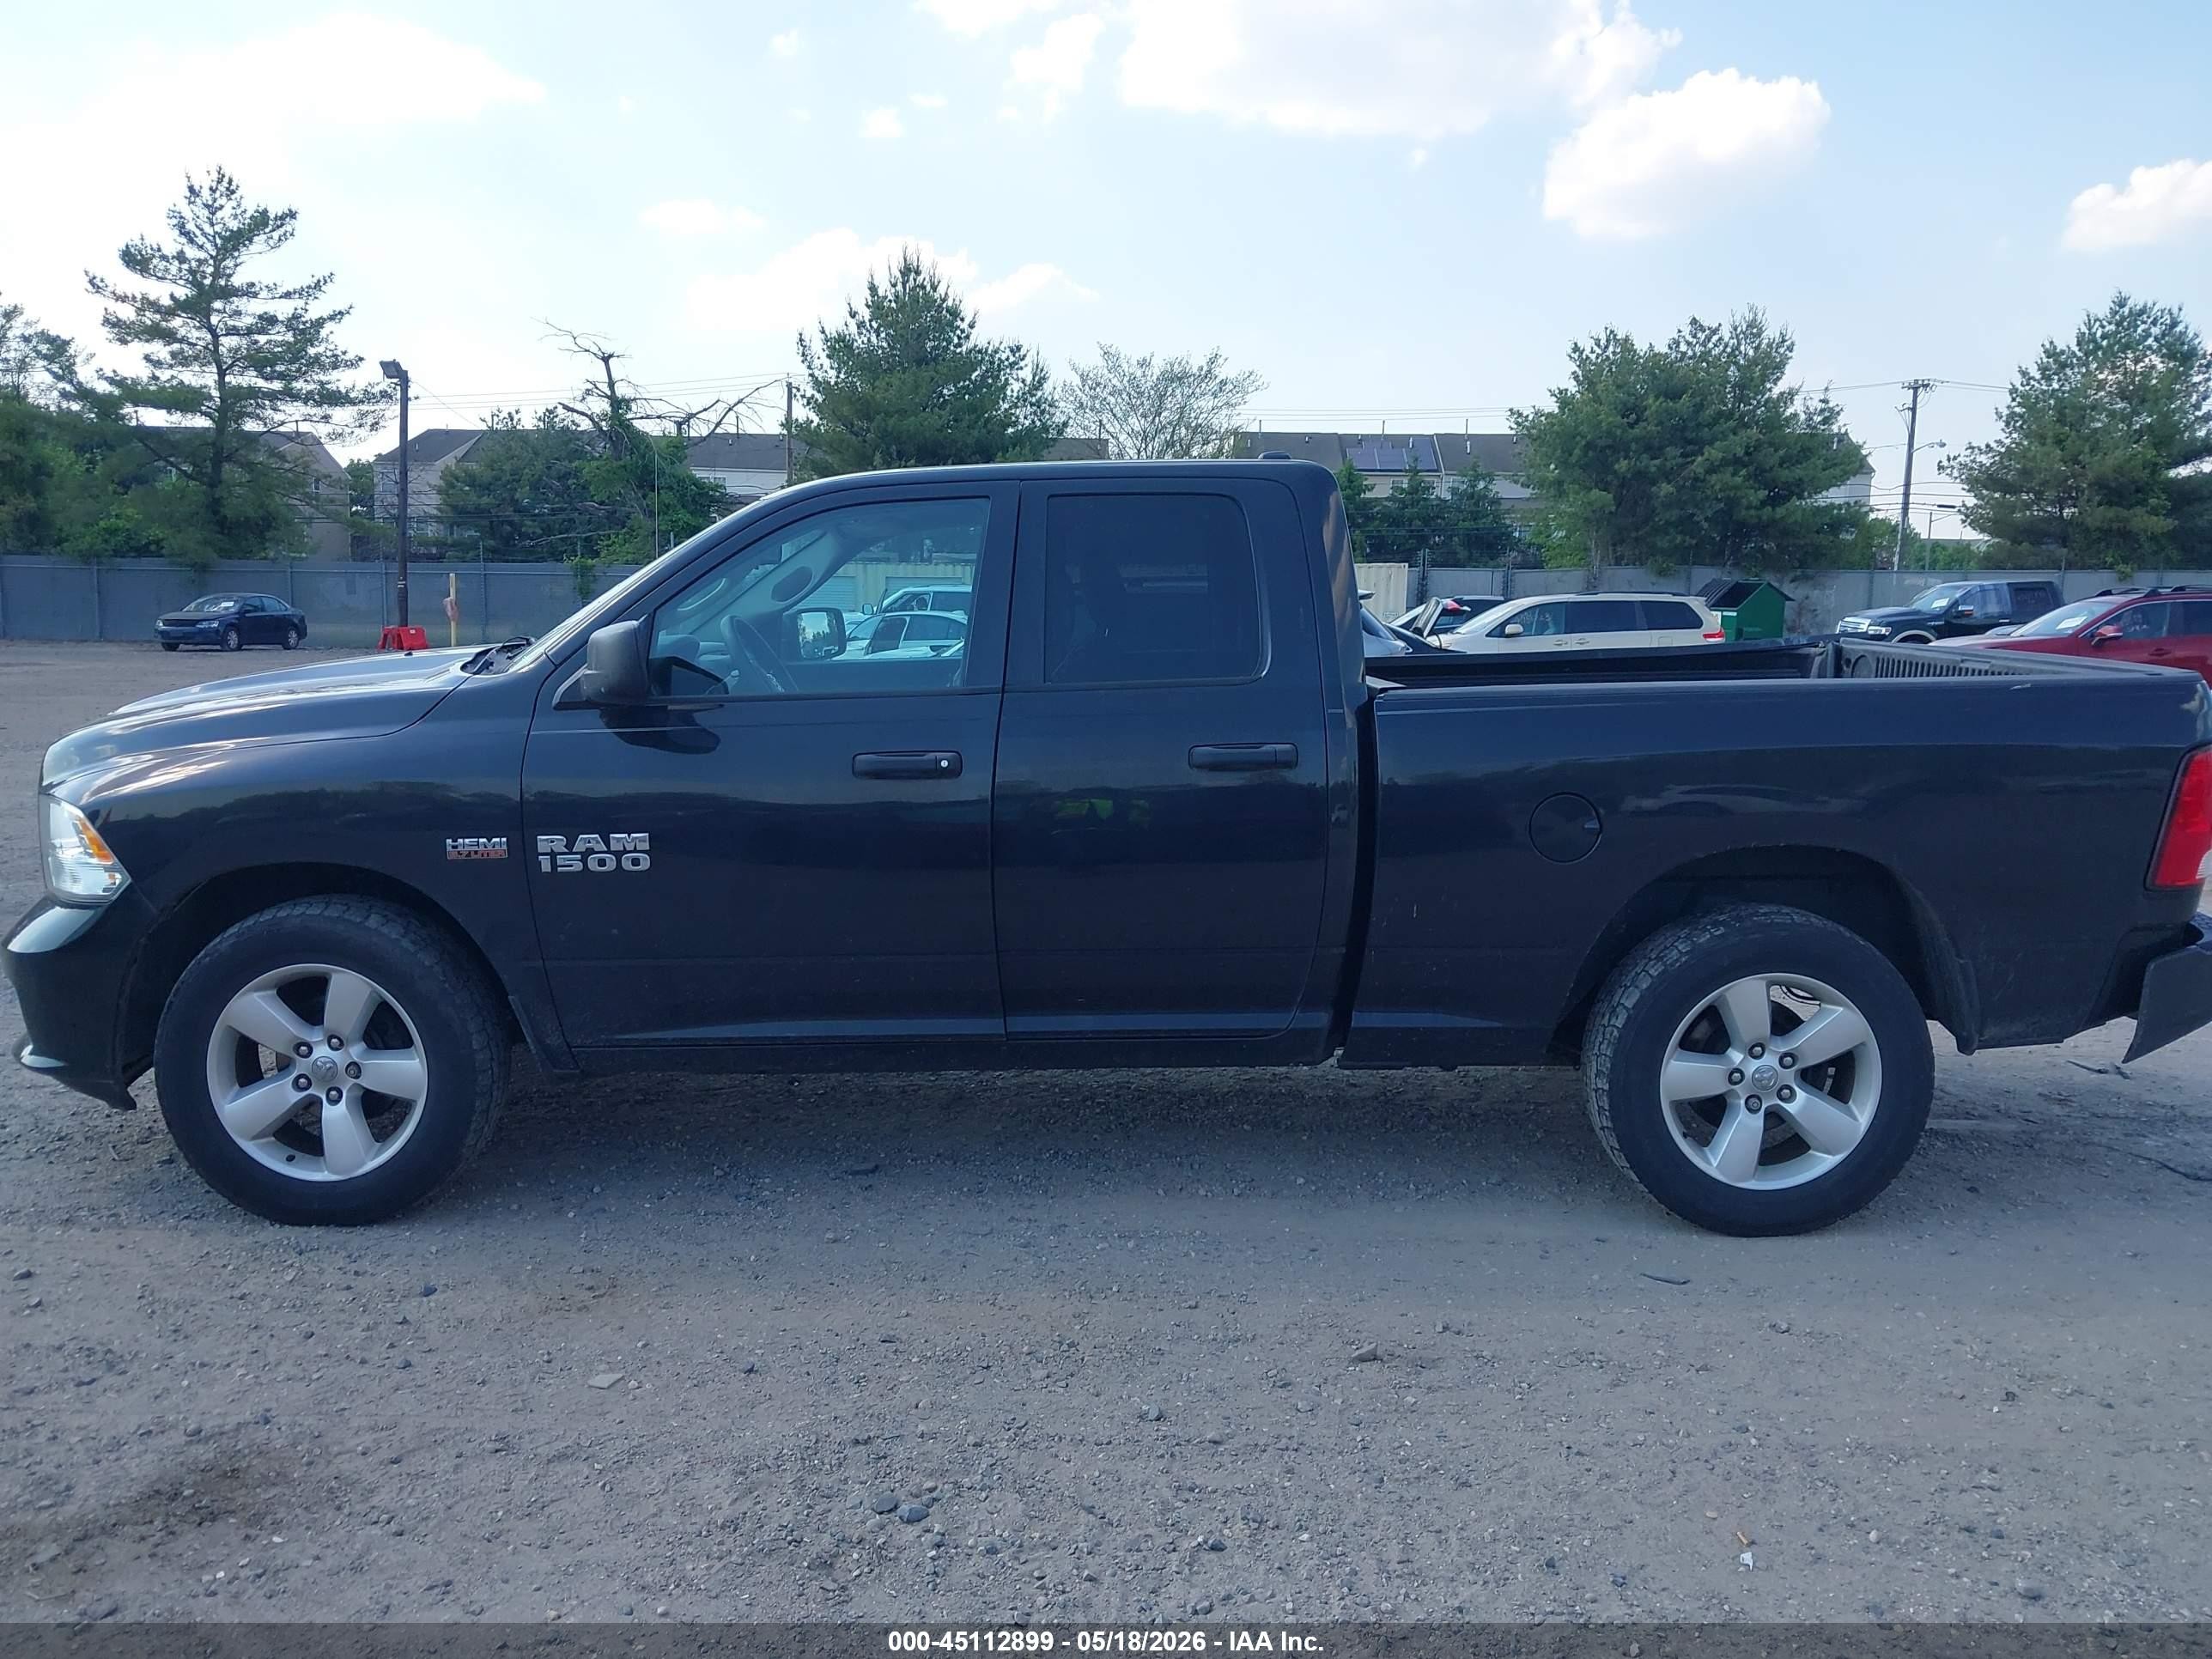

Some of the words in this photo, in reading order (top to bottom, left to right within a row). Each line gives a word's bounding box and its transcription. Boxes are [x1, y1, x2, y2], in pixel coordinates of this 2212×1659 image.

[446, 837, 507, 851] HEMI
[537, 833, 651, 853] RAM
[538, 853, 651, 873] 1500
